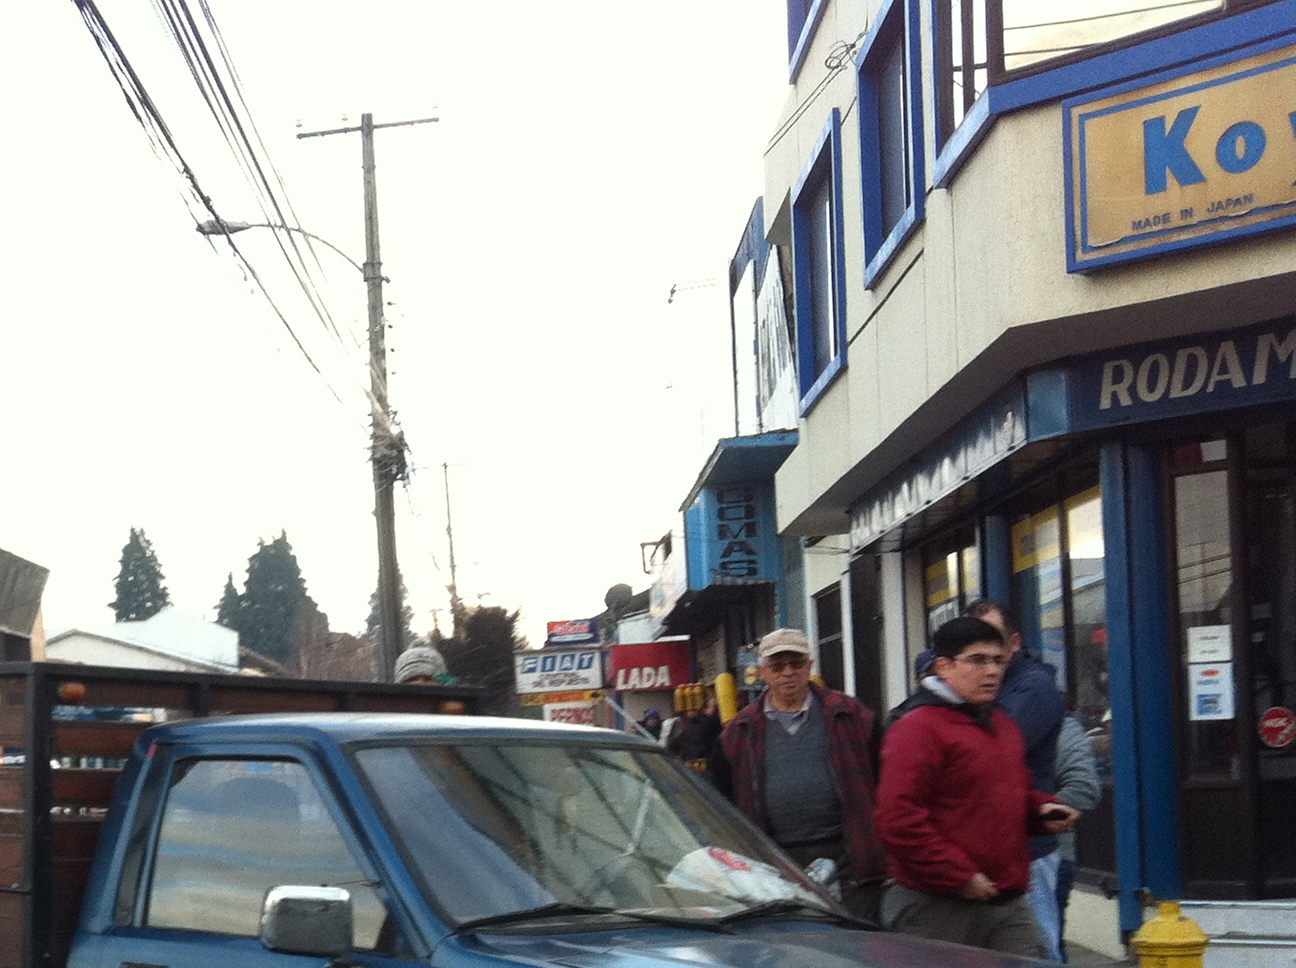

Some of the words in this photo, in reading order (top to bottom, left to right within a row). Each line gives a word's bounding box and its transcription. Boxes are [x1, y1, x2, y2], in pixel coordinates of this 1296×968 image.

[1142, 103, 1296, 195] Ko
[1132, 212, 1171, 231] MADE
[1180, 207, 1194, 221] IN
[1207, 193, 1254, 213] JAPAN
[522, 653, 595, 674] FIAT
[616, 665, 671, 691] LADA
